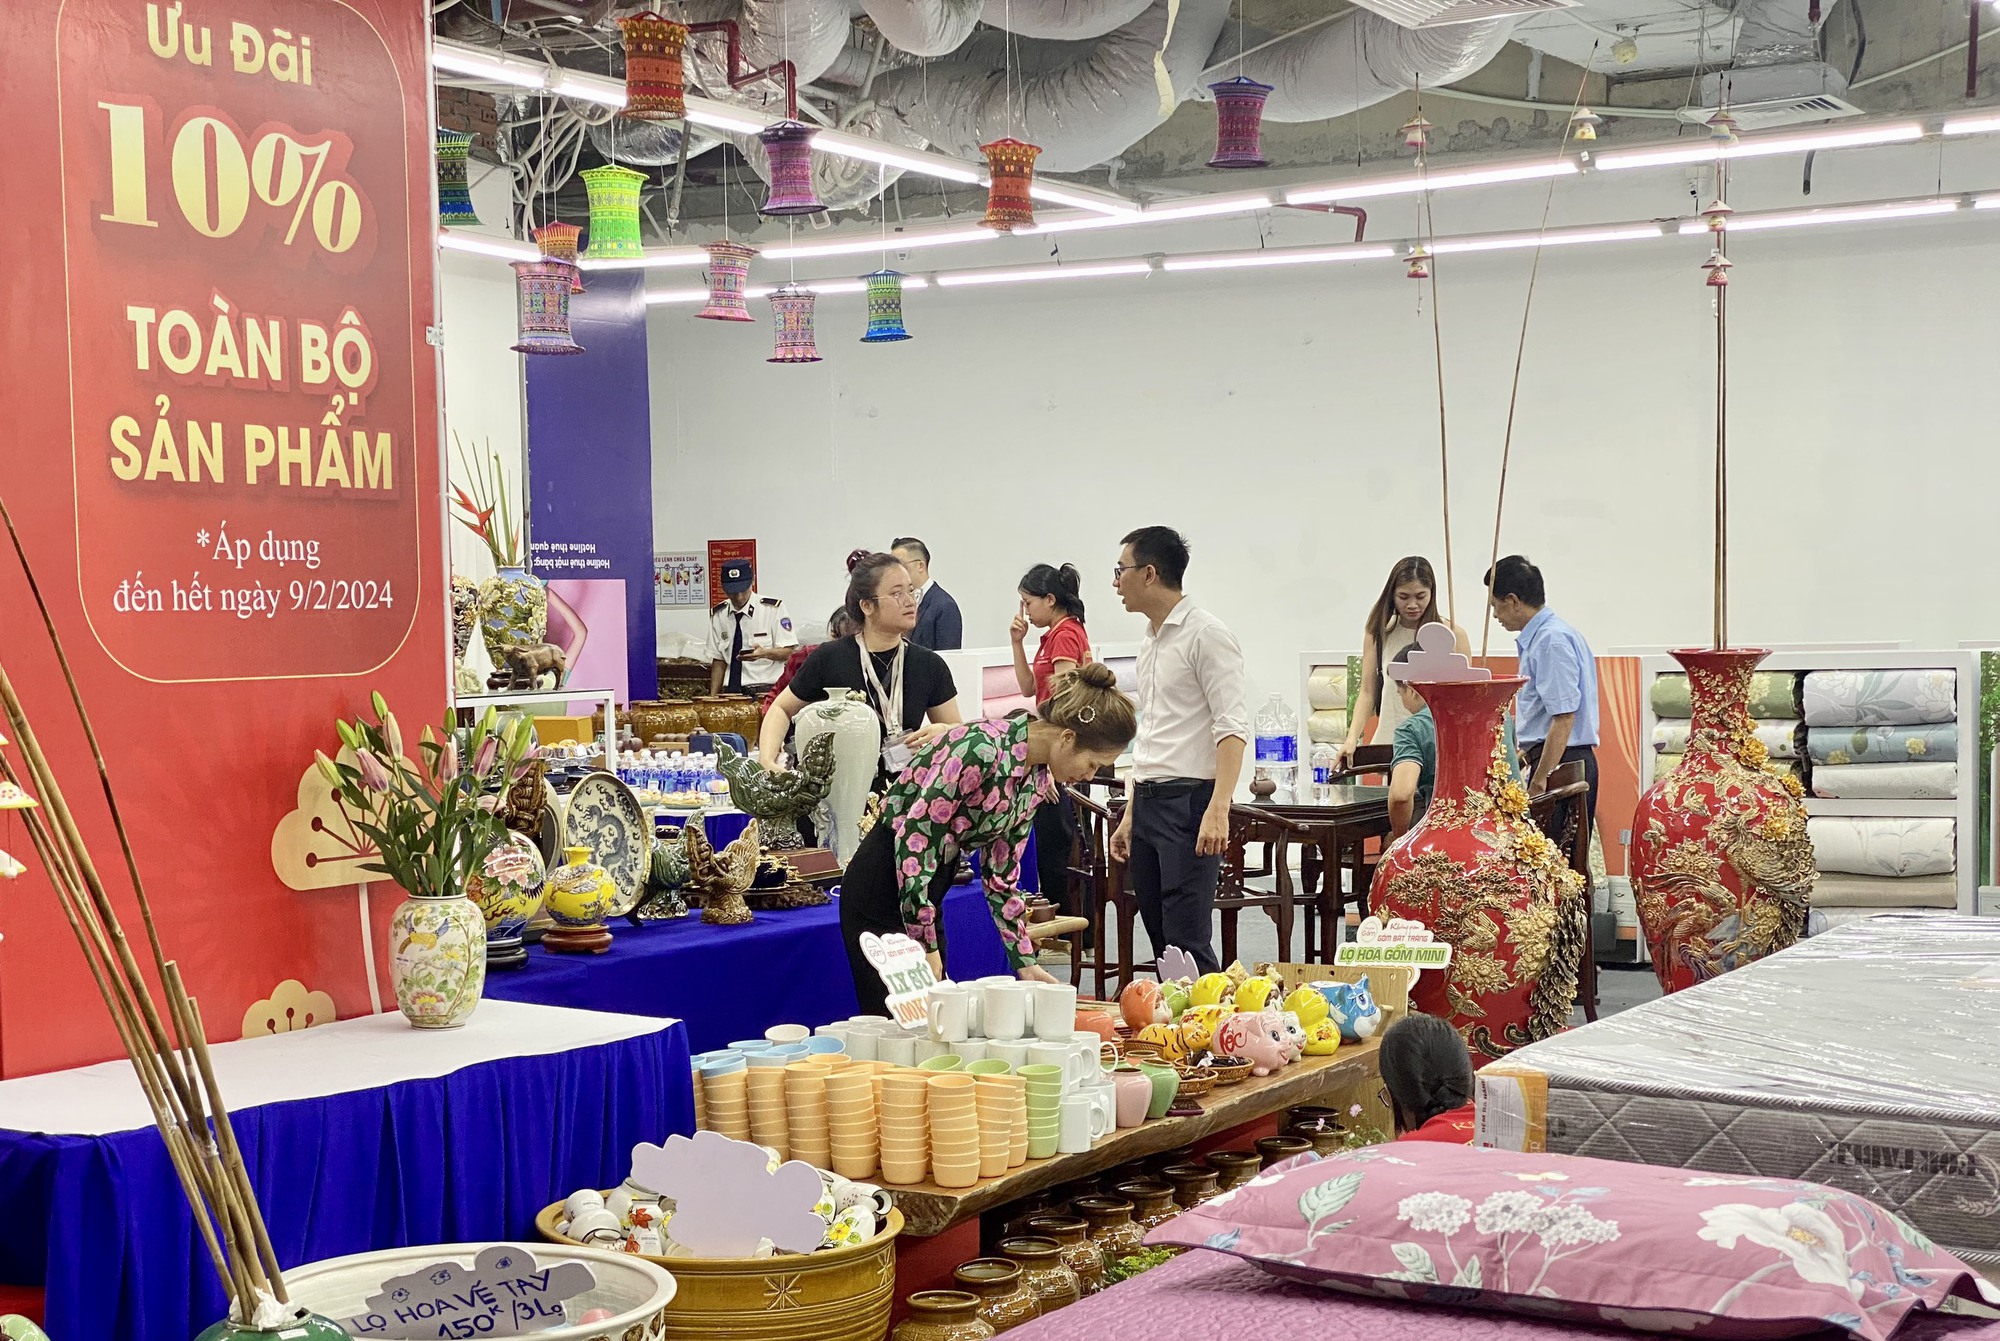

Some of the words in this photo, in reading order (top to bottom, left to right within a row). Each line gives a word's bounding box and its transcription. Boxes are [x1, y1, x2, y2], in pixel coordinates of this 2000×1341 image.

[147, 1, 212, 66] Ưu
[230, 22, 312, 85] Đãi
[98, 101, 362, 253] 10%
[126, 293, 282, 381] TOÀN
[301, 310, 372, 405] BỘ
[109, 394, 224, 483] SẢN
[244, 394, 393, 490] PHẨM
[259, 530, 321, 569] dụng
[550, 543, 568, 553] thuê
[569, 543, 596, 554] Hotline
[569, 559, 585, 569] thuê
[586, 558, 610, 569] Hotline
[113, 571, 163, 612] đến
[171, 571, 213, 612] hết
[220, 580, 282, 619] ngày
[289, 580, 393, 611] 9/2/2024
[1340, 948, 1355, 963] LỌ
[1357, 948, 1381, 961] HOA
[1384, 944, 1412, 961] GỐM
[1414, 949, 1446, 962] MINI
[885, 972, 912, 995] LY
[351, 1314, 387, 1332] LỌ
[393, 1297, 459, 1325] HOA
[496, 1268, 550, 1298] TAY
